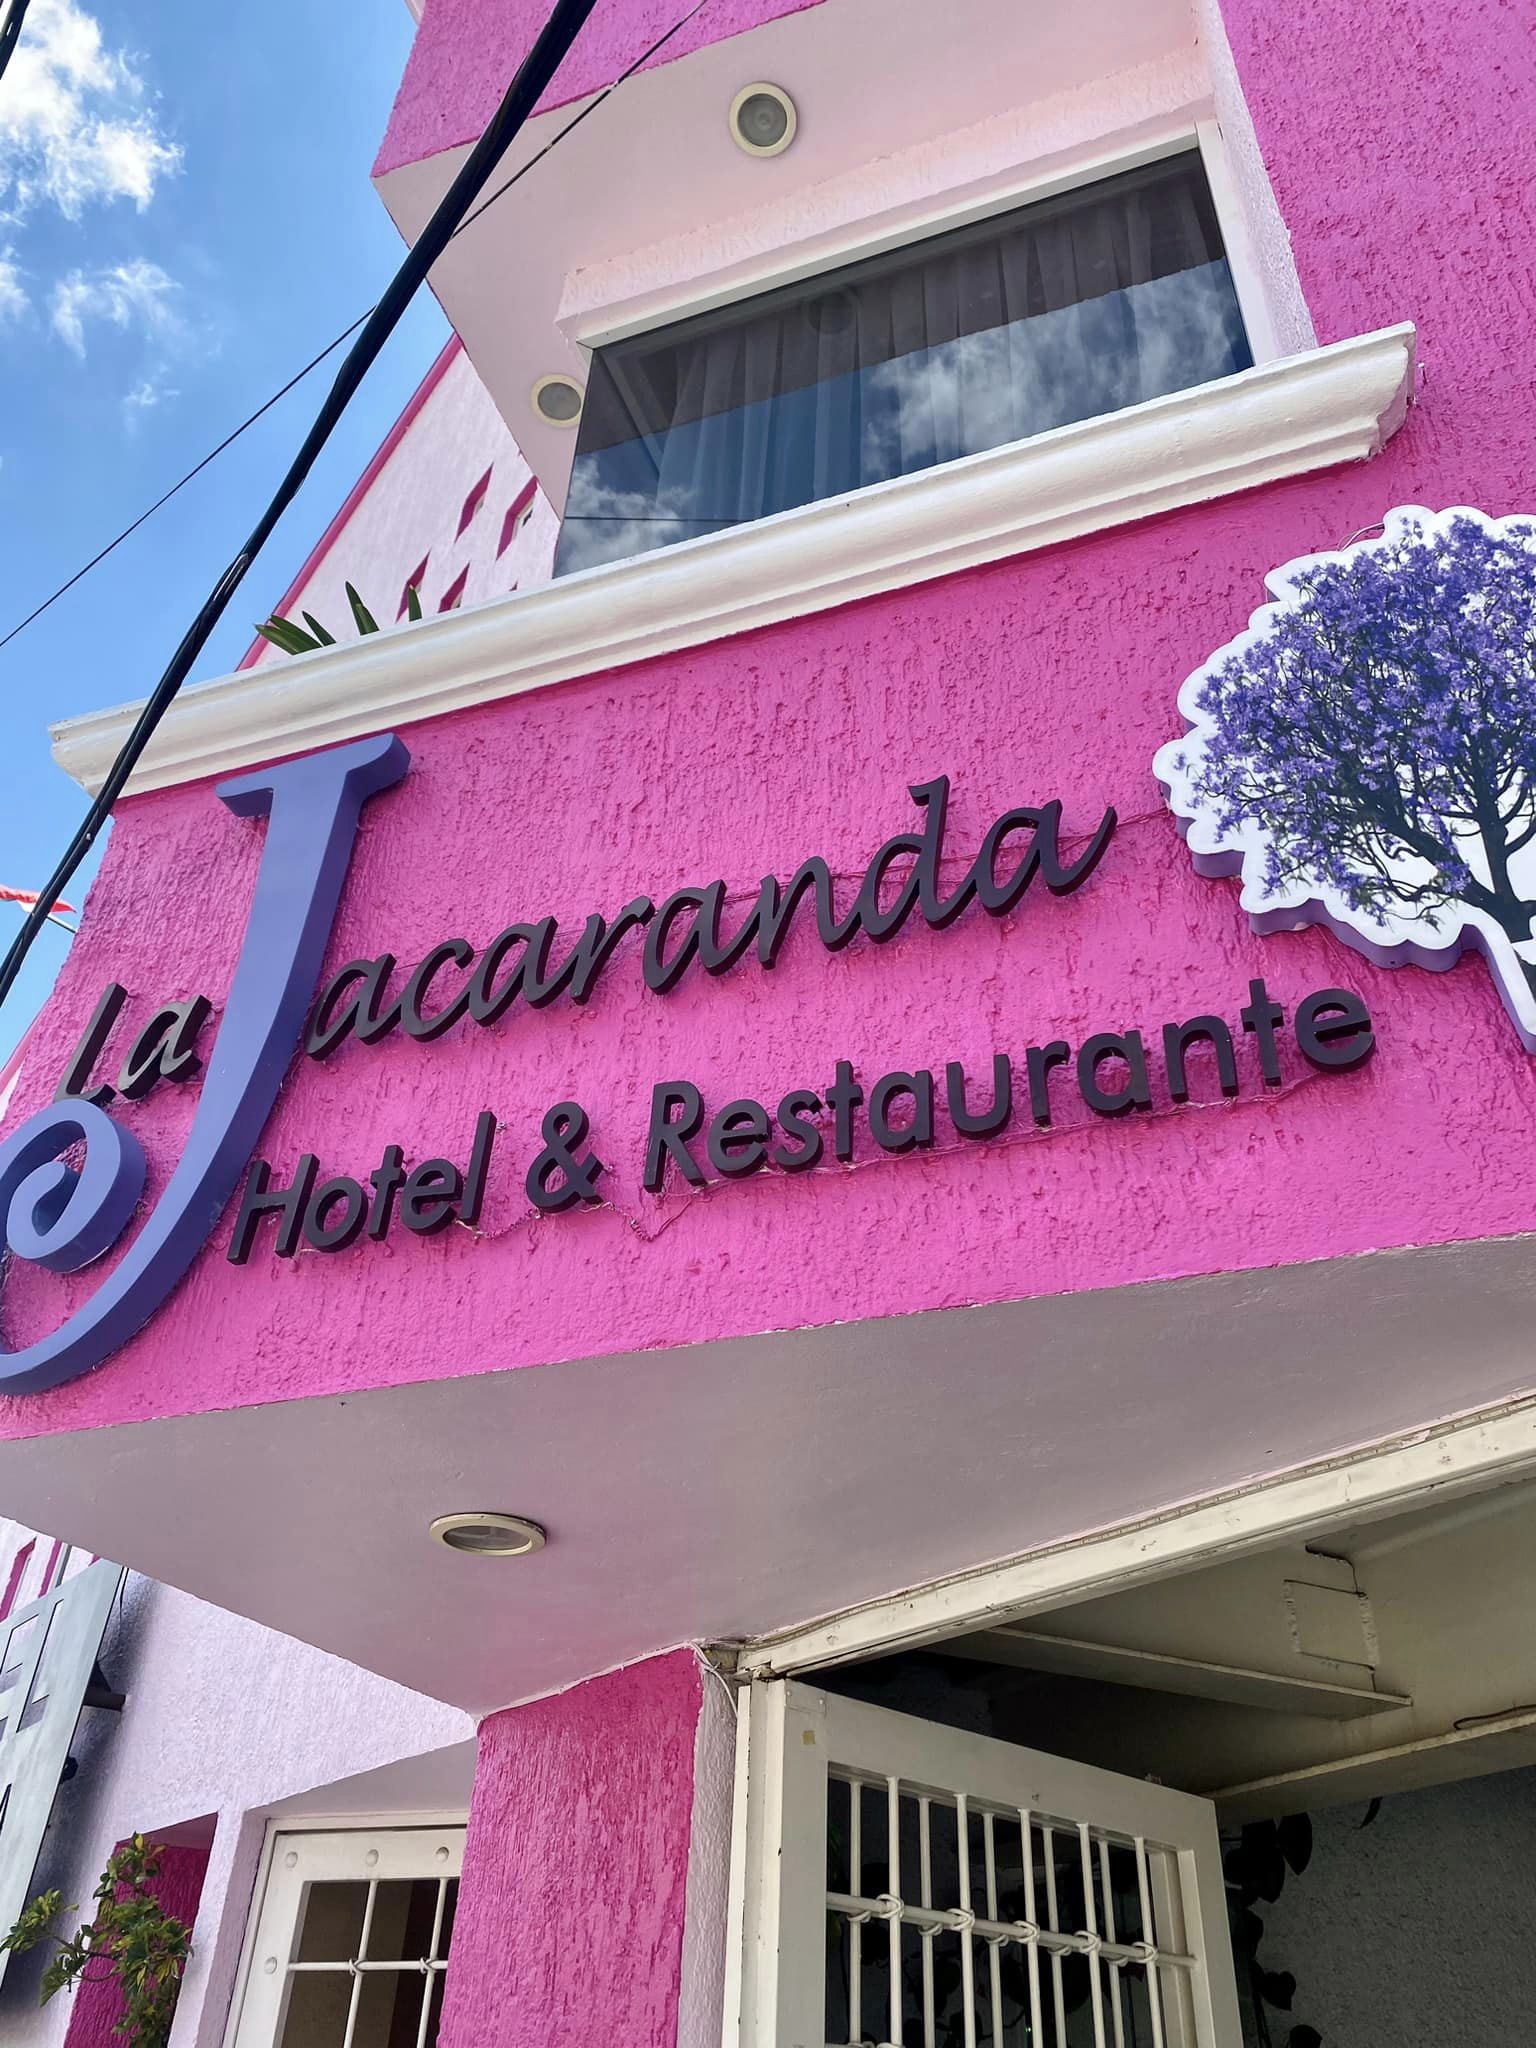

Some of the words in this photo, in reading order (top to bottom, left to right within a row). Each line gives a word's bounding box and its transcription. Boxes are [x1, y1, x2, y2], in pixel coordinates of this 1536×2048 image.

[0, 732, 1117, 1396] Jacaranda
[53, 982, 213, 1104] La
[227, 1110, 498, 1266] Hotel
[525, 1101, 602, 1214] &
[643, 977, 1377, 1194] Restaurante
